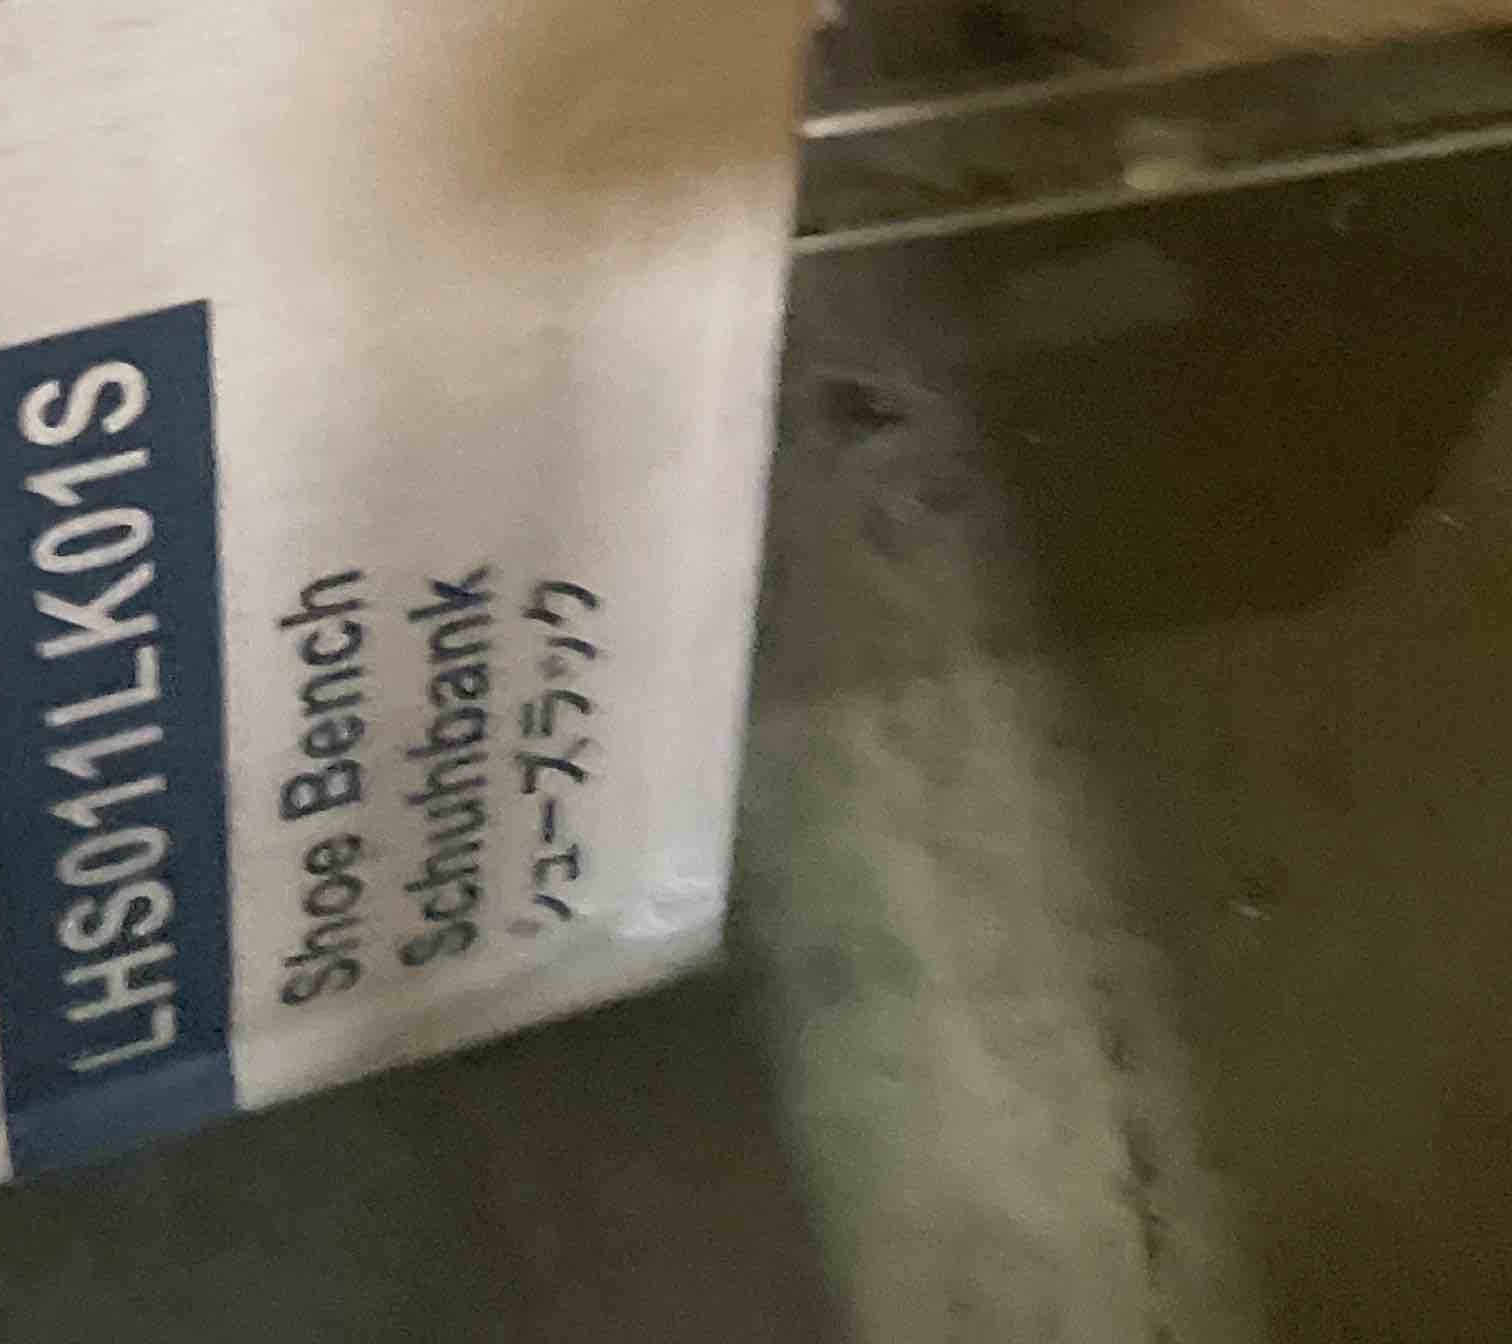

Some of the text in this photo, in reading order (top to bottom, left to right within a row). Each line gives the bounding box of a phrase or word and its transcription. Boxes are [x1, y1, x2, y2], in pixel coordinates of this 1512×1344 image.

[19, 359, 176, 1073] LHS011LK01S
[276, 568, 367, 1007] Shoe Bench
[398, 562, 498, 970] Schuhbank
